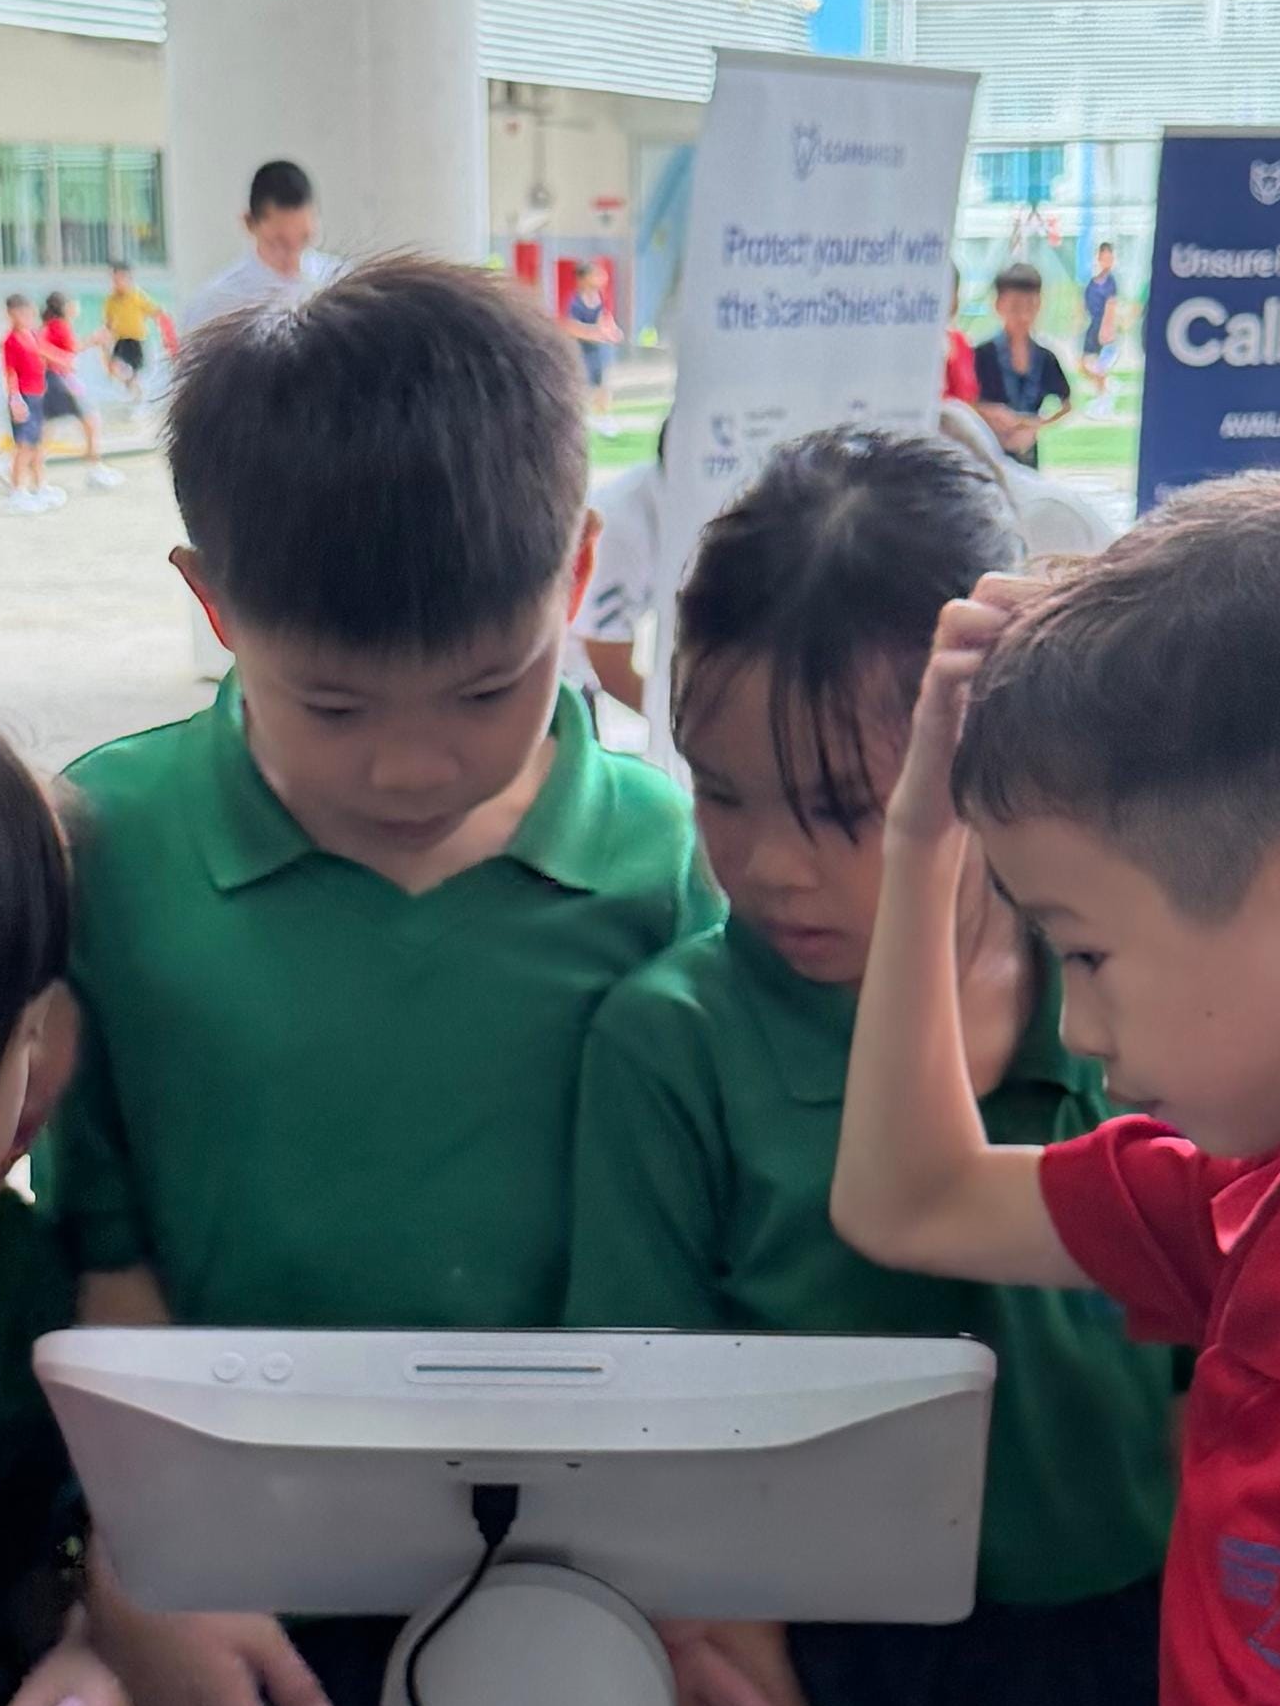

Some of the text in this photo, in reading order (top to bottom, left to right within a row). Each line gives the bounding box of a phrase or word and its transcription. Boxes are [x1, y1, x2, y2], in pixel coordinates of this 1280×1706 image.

[723, 226, 943, 276] Protect yourself with
[1170, 243, 1276, 279] Unsure
[717, 291, 758, 330] the
